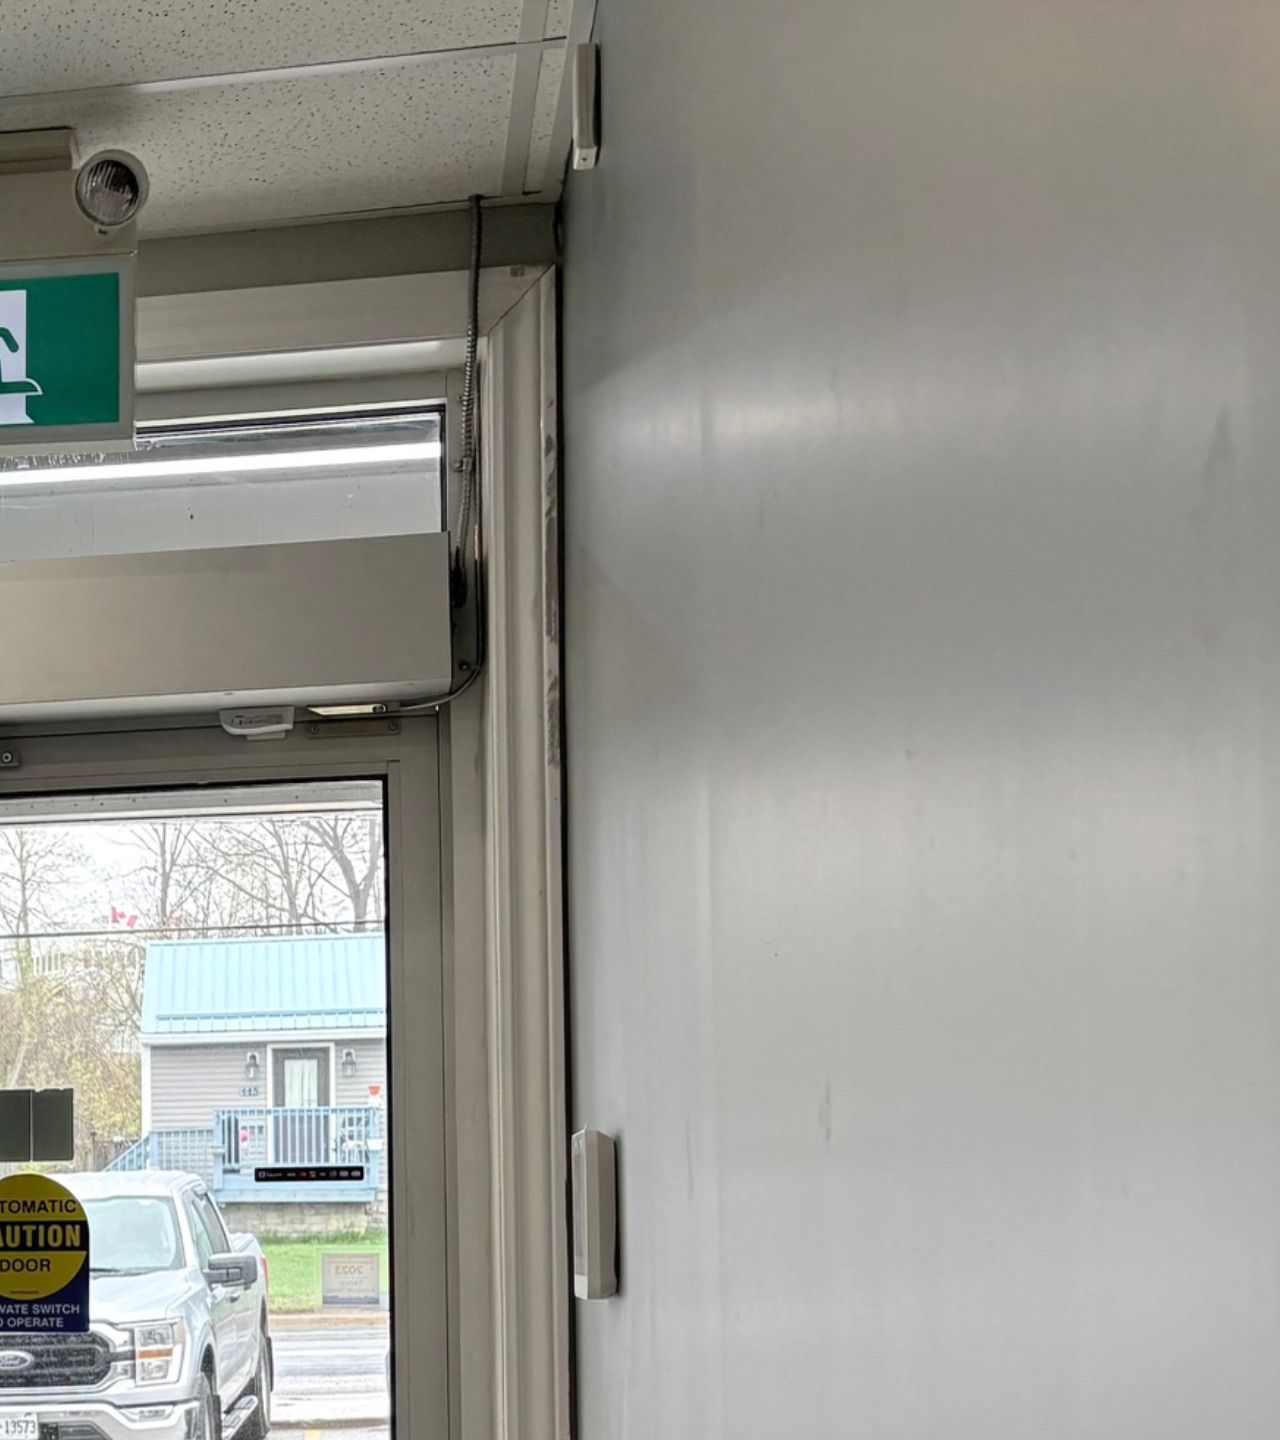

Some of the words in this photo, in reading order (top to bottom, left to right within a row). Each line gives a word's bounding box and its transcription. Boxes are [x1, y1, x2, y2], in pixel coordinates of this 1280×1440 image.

[0, 1258, 51, 1273] DOOR
[32, 1303, 80, 1315] SWITCH
[7, 1316, 64, 1328] OPERATE
[5, 1419, 36, 1434] 13573
